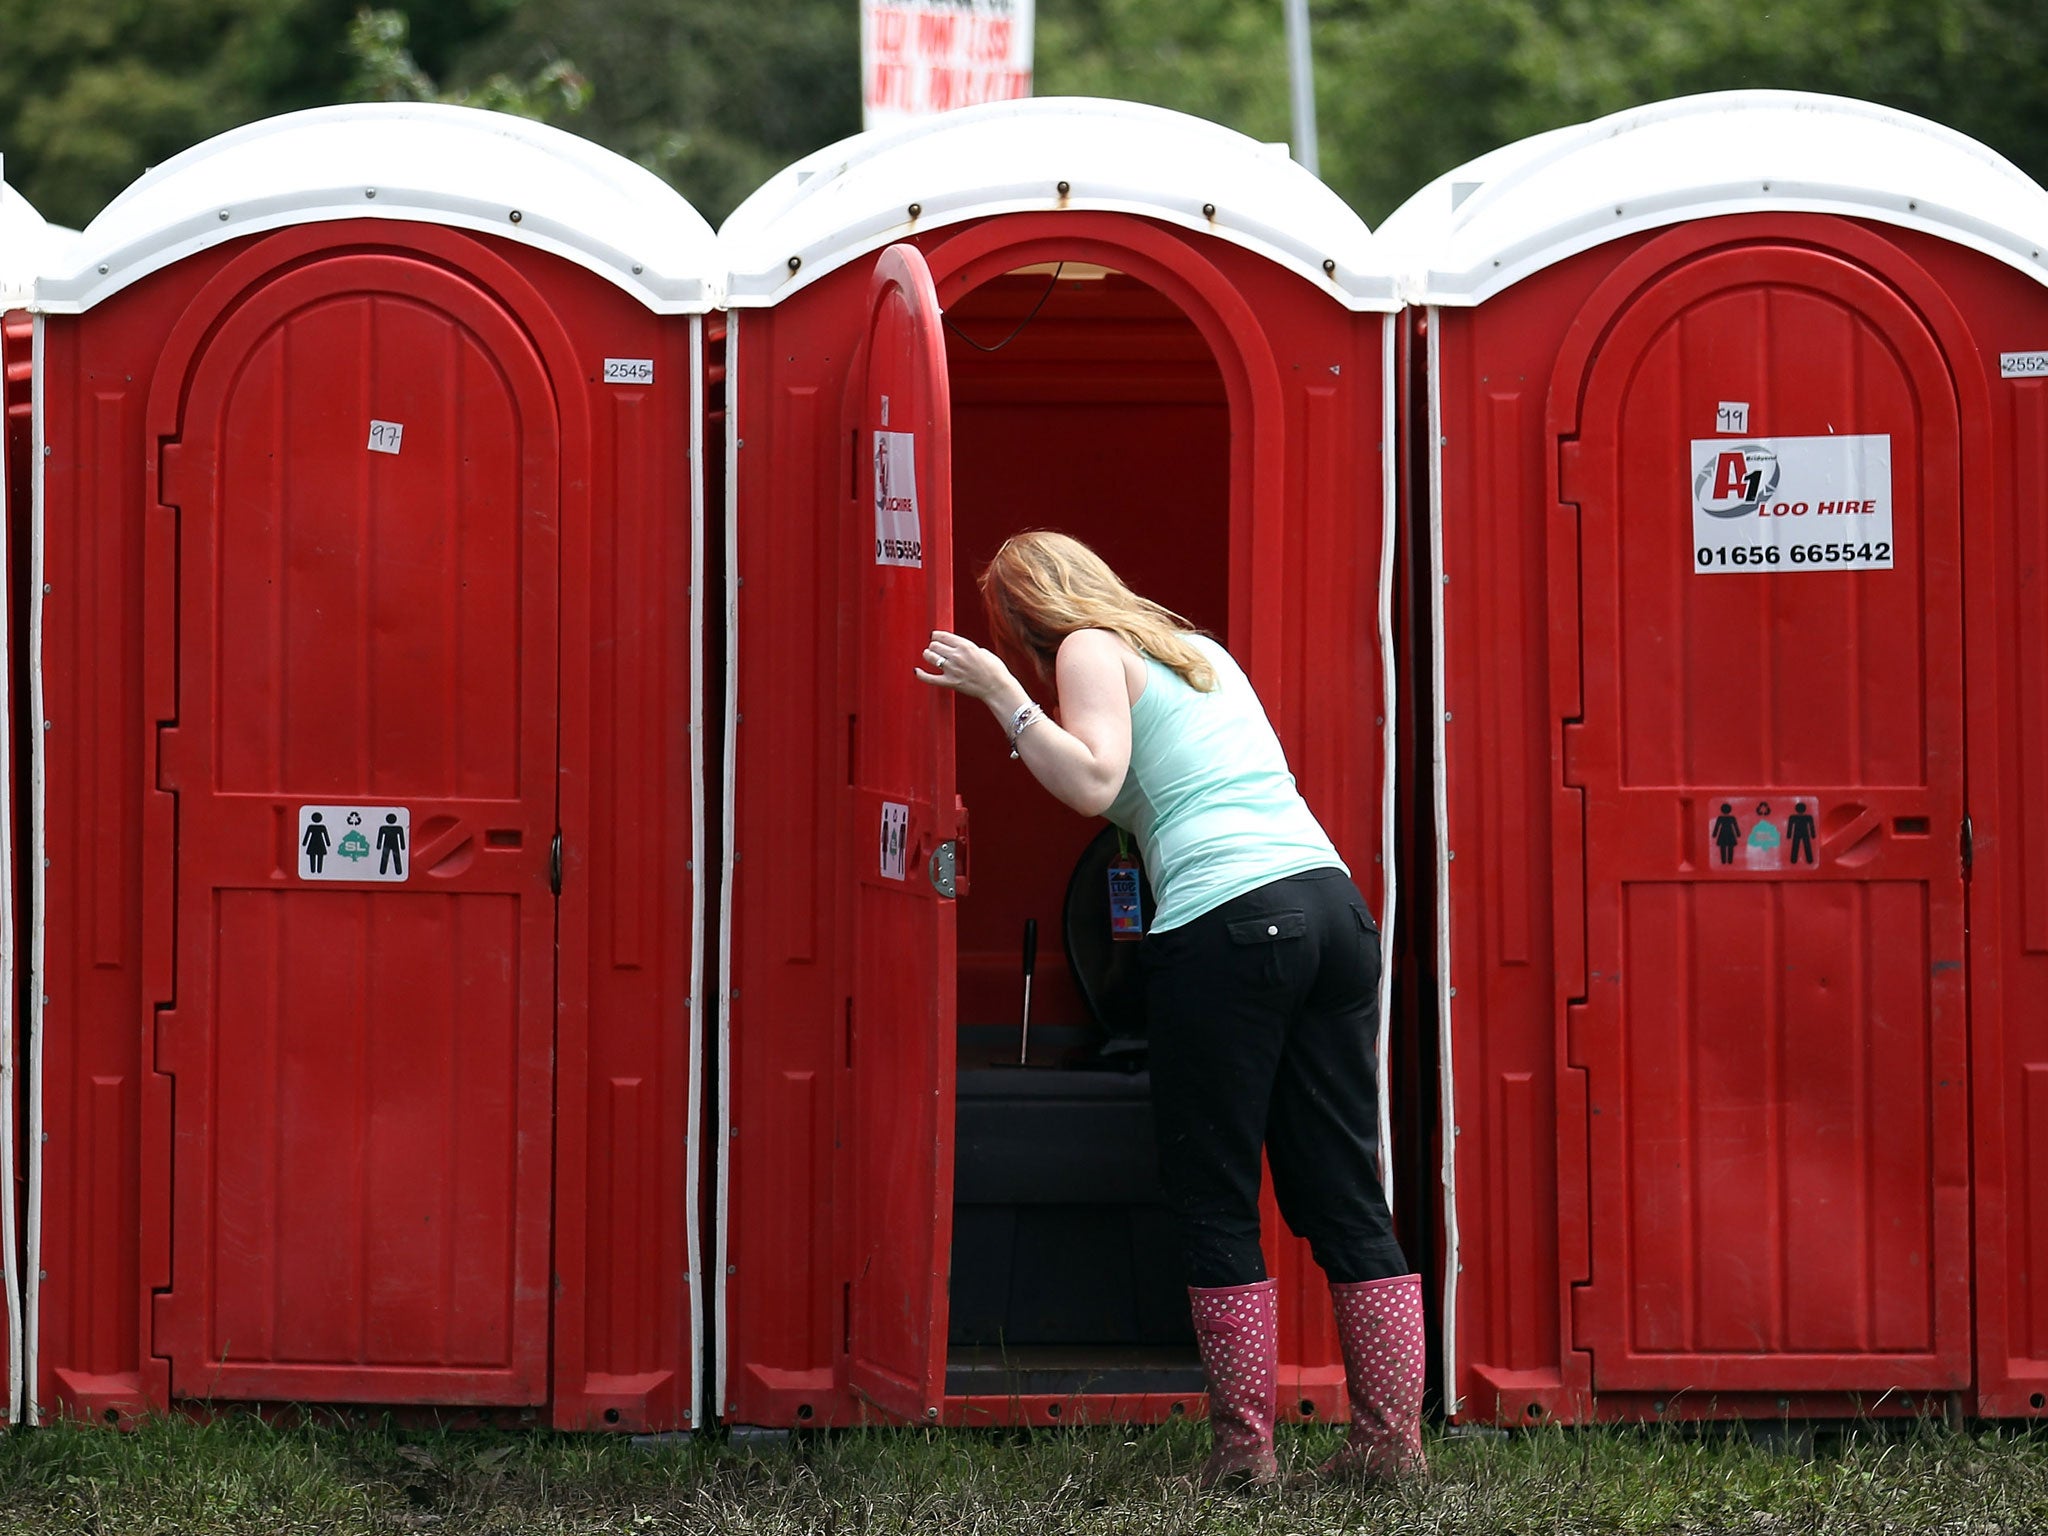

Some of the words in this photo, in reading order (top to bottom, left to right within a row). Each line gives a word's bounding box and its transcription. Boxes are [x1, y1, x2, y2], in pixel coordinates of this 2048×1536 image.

[610, 363, 648, 378] 2545
[2007, 357, 2045, 373] 2552
[1717, 407, 1743, 431] 99
[372, 424, 400, 446] 97
[1713, 451, 1762, 503] A1
[1758, 502, 1809, 517] LOO
[1817, 500, 1877, 516] HIRE
[1697, 545, 1781, 566] 01656
[1789, 542, 1891, 564] 665542
[344, 840, 367, 852] SL
